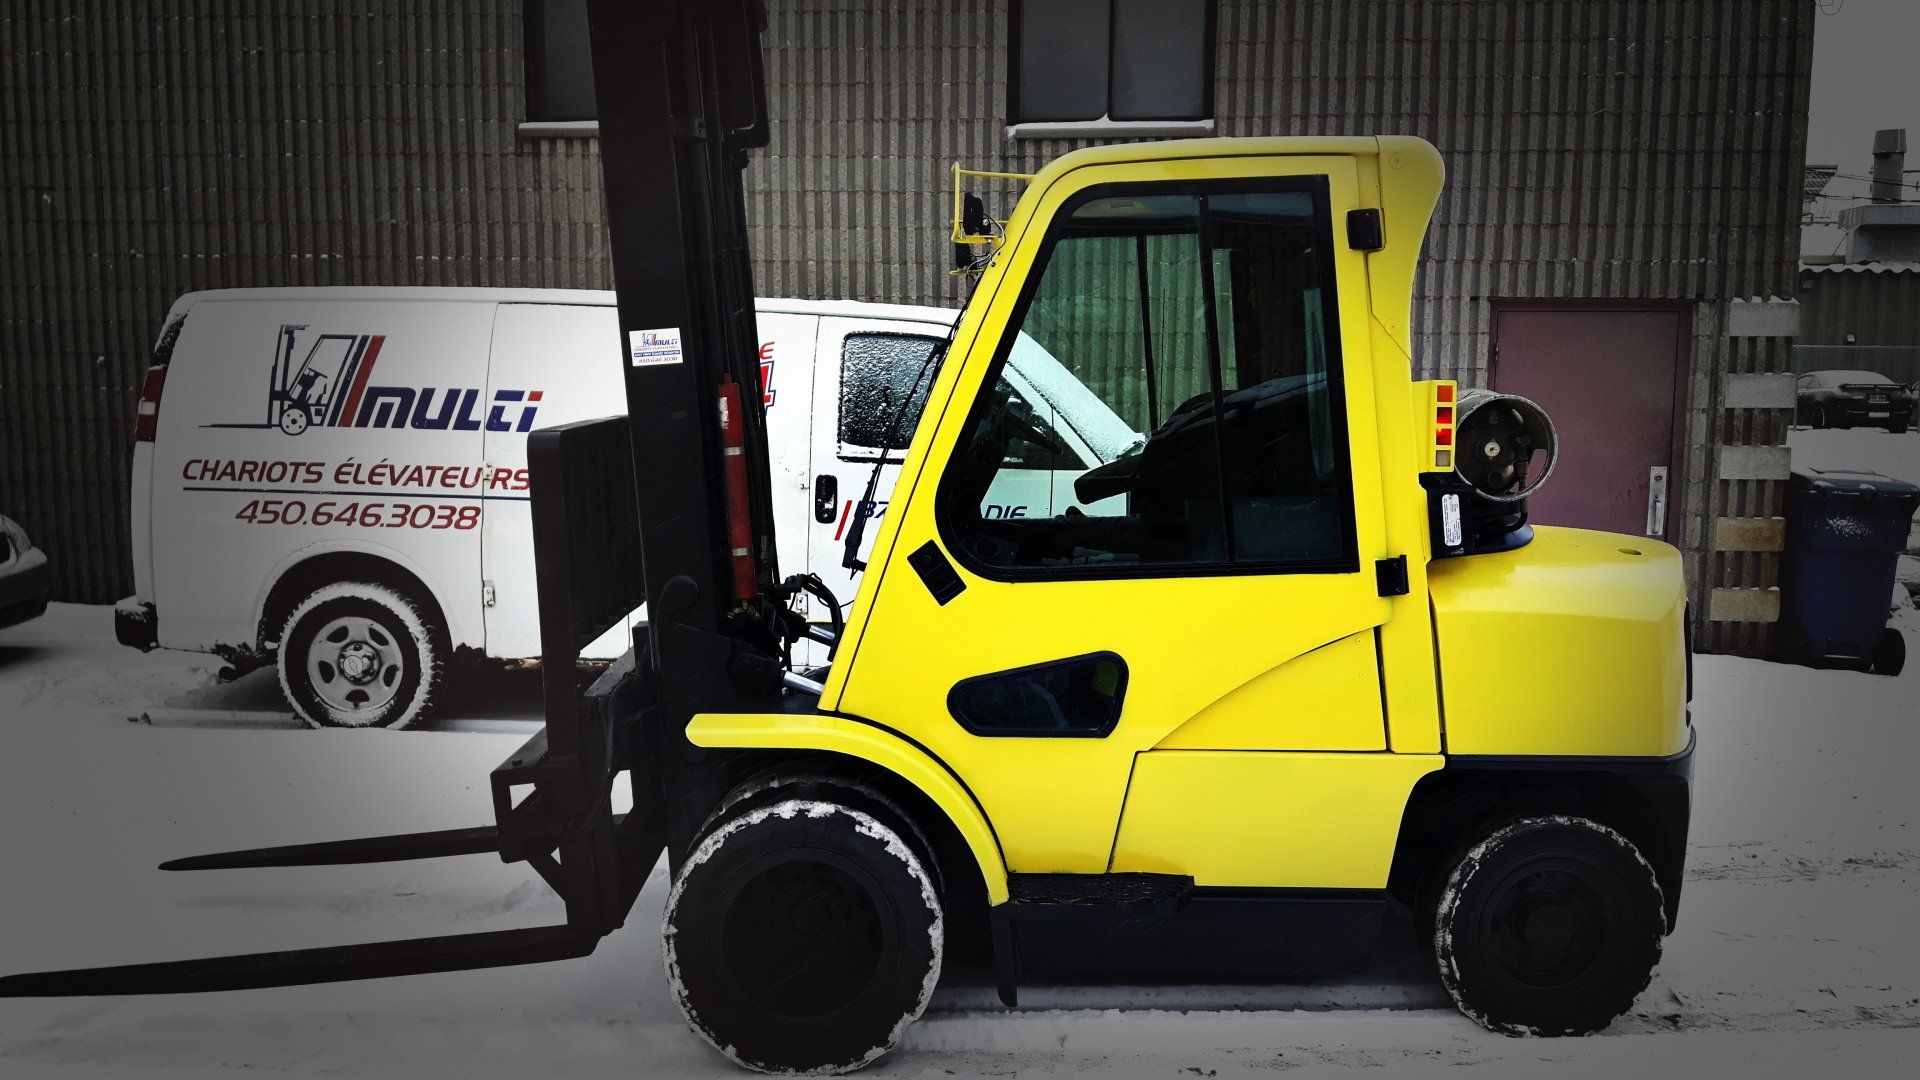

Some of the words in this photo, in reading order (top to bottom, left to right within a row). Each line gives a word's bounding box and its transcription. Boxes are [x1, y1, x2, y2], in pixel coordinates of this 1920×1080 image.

[182, 458, 326, 484] CHARIOTS
[333, 456, 531, 491] ÉLÉVATEURS
[235, 500, 482, 531] 450.646.3038
